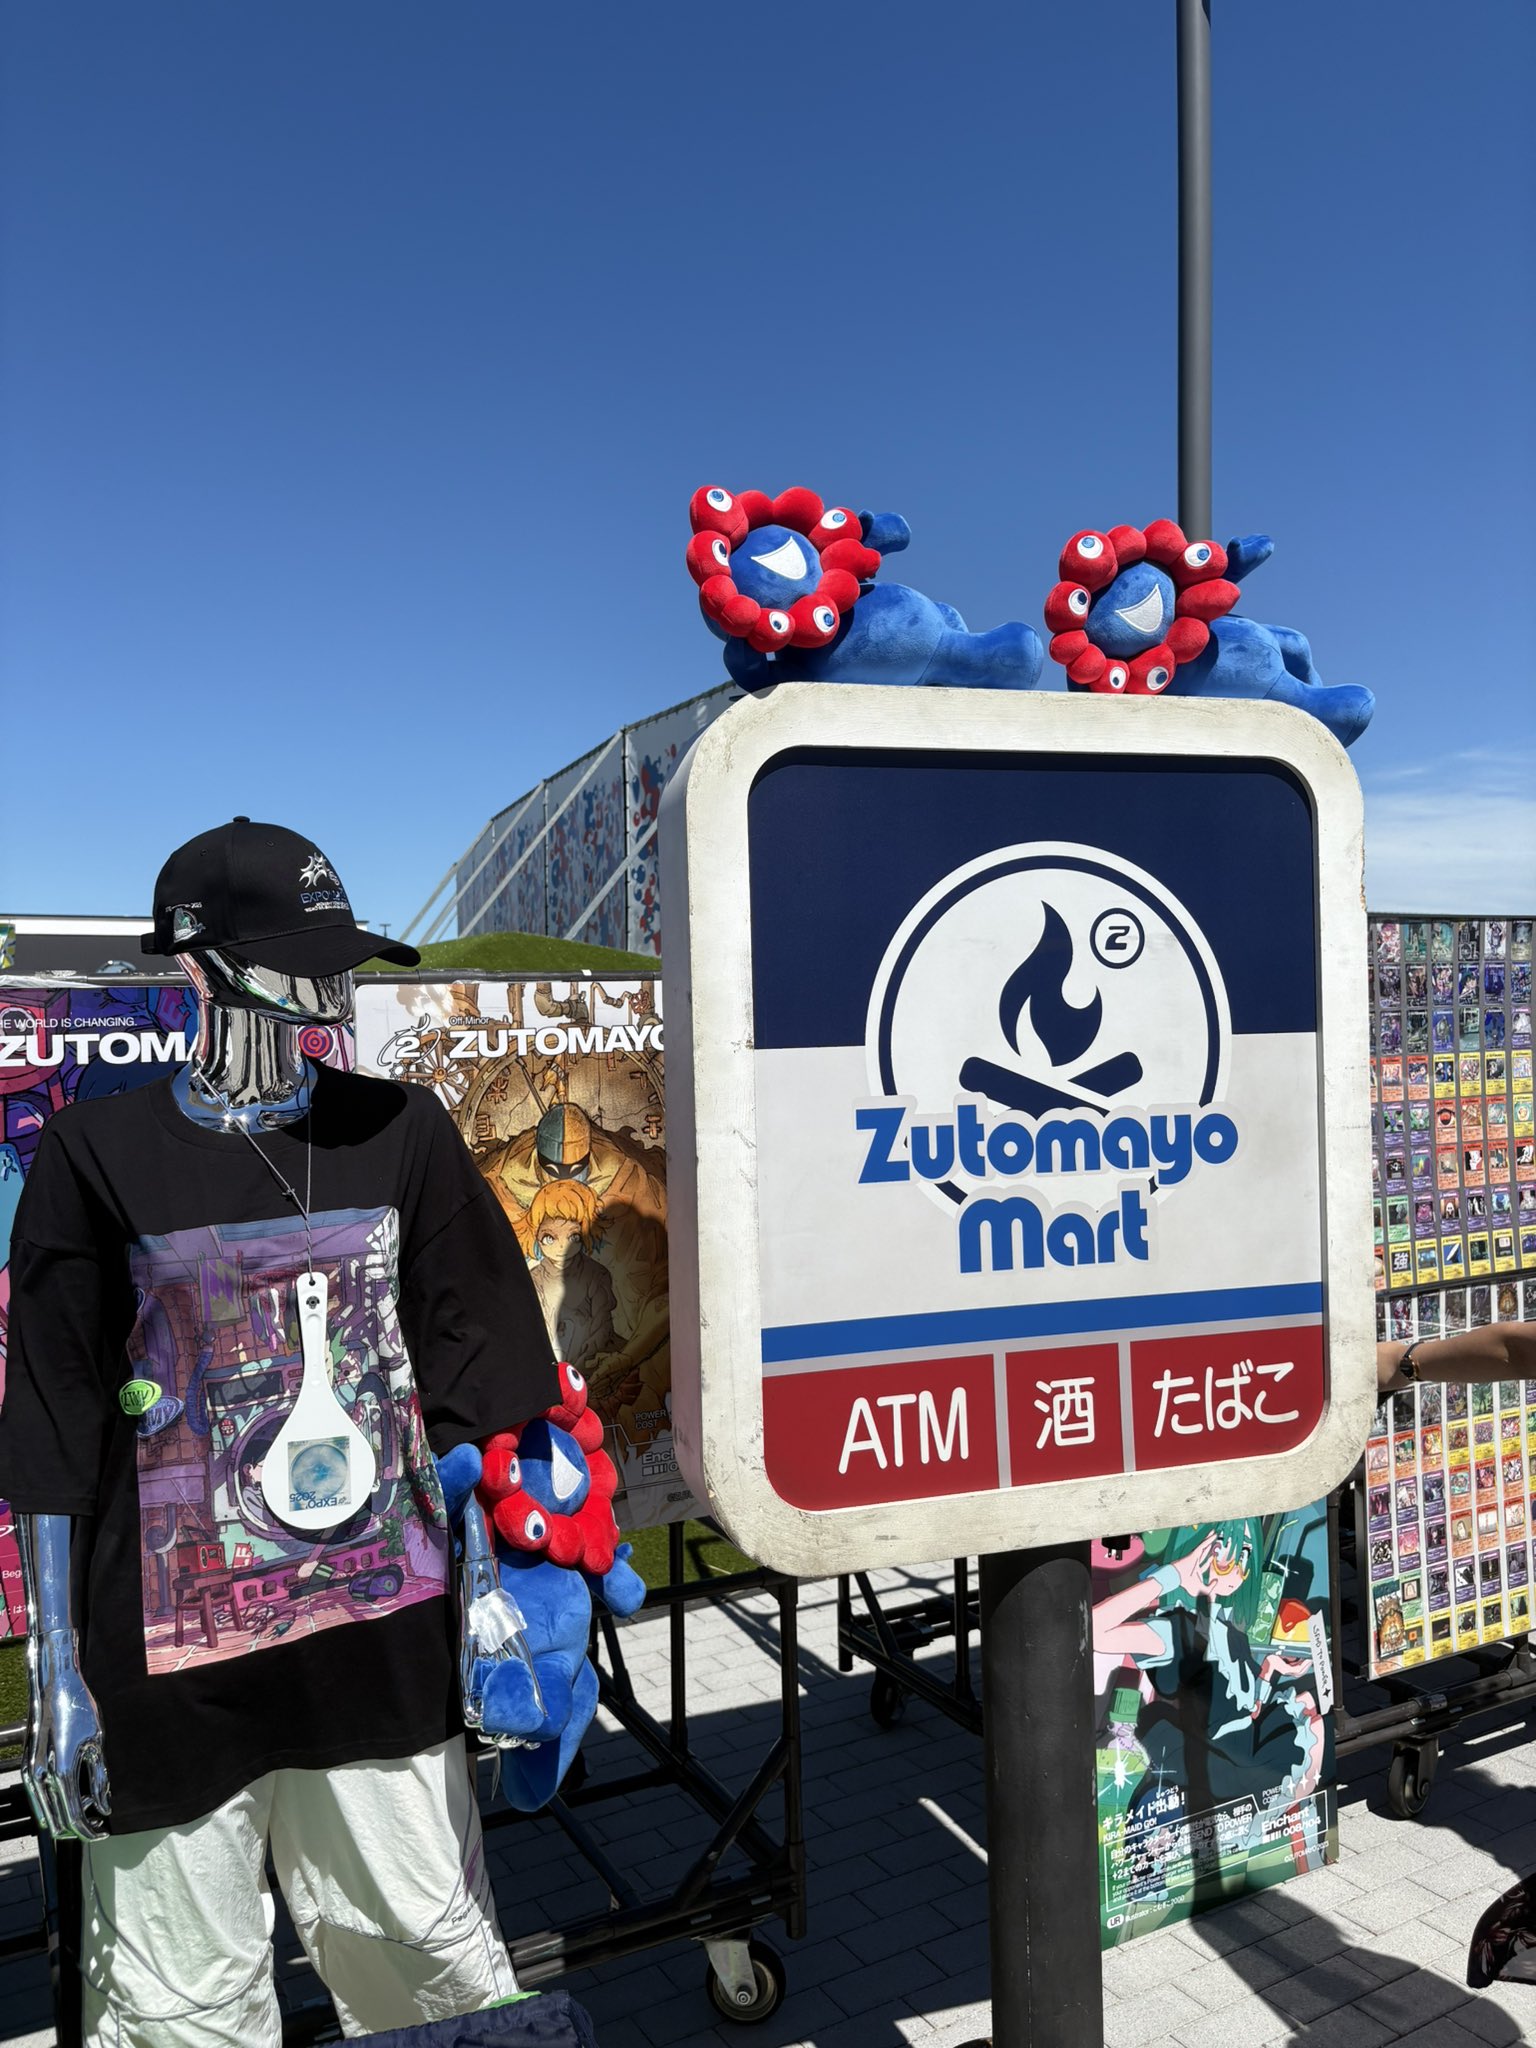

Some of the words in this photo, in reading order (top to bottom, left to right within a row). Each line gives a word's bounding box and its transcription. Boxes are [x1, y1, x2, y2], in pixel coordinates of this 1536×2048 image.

[14, 1018, 58, 1029] WORLD
[61, 1018, 71, 1028] IS
[74, 1016, 138, 1028] CHANGING.
[465, 1016, 490, 1026] Minor
[855, 1104, 1239, 1186] Zutomayo
[958, 1189, 1149, 1274] Mart
[1152, 1358, 1300, 1438] たばこ
[635, 1409, 667, 1421] POWER
[635, 1420, 658, 1430] COST
[1034, 1376, 1096, 1450] 酒
[838, 1386, 970, 1475] ATM
[289, 1491, 316, 1503] 2025
[1261, 1806, 1310, 1833] Enchant
